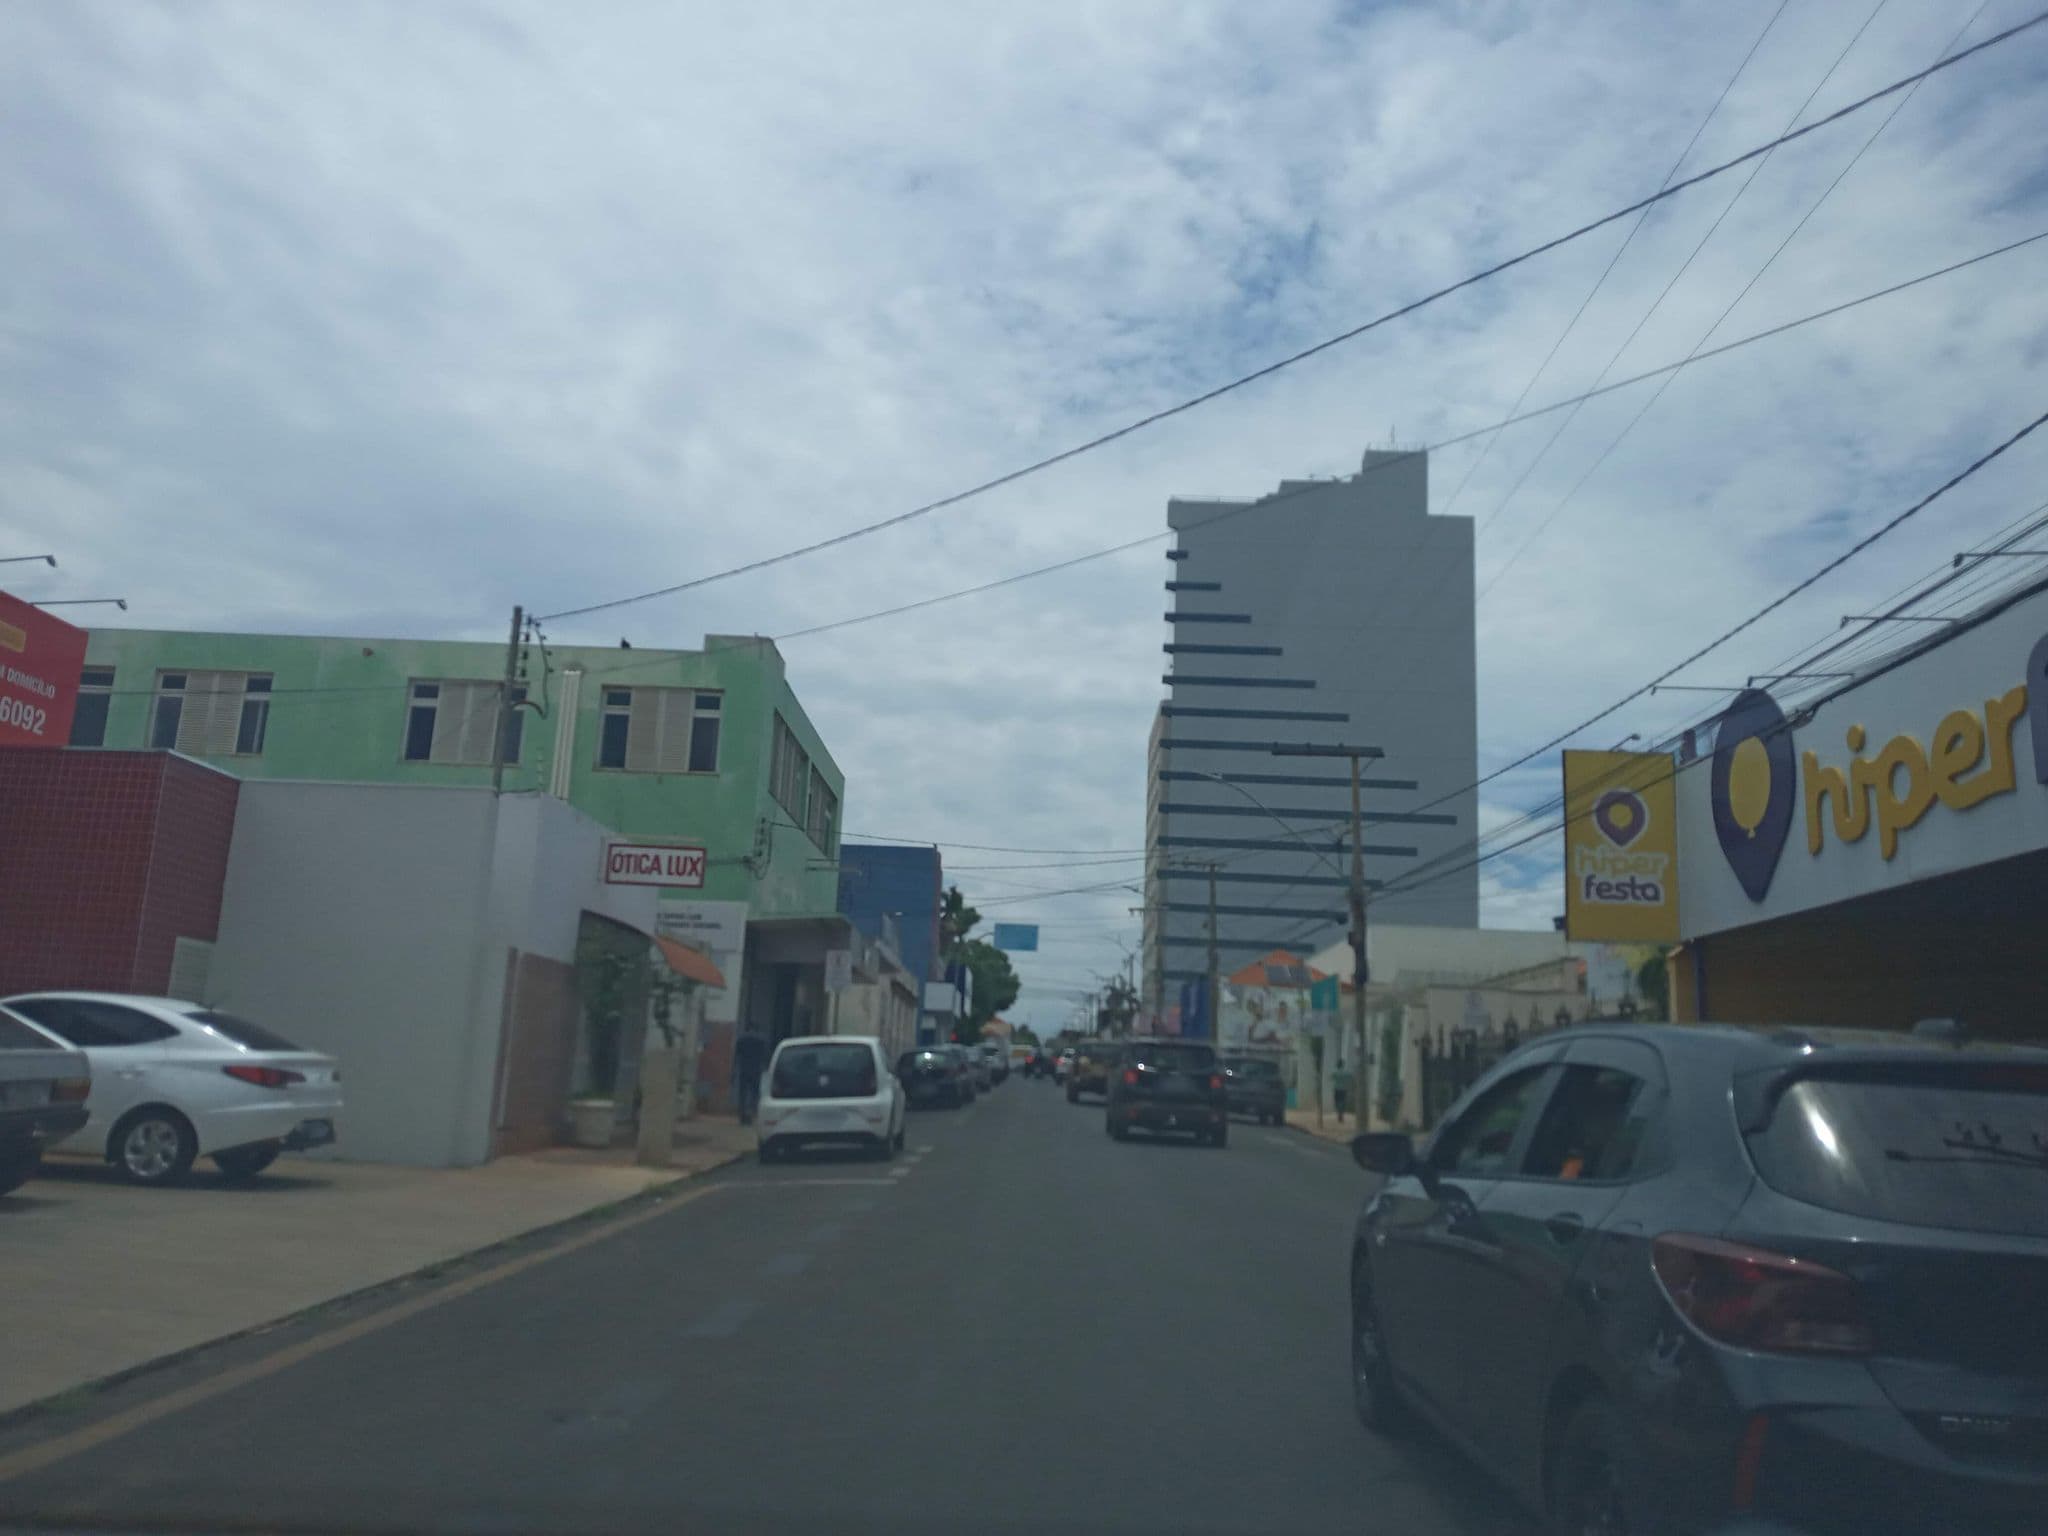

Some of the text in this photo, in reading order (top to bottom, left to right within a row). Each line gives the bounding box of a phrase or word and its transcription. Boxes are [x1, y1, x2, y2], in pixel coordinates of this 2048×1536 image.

[1802, 684, 2028, 861] hiper
[667, 855, 701, 877] LUX
[1585, 874, 1660, 901] festa
